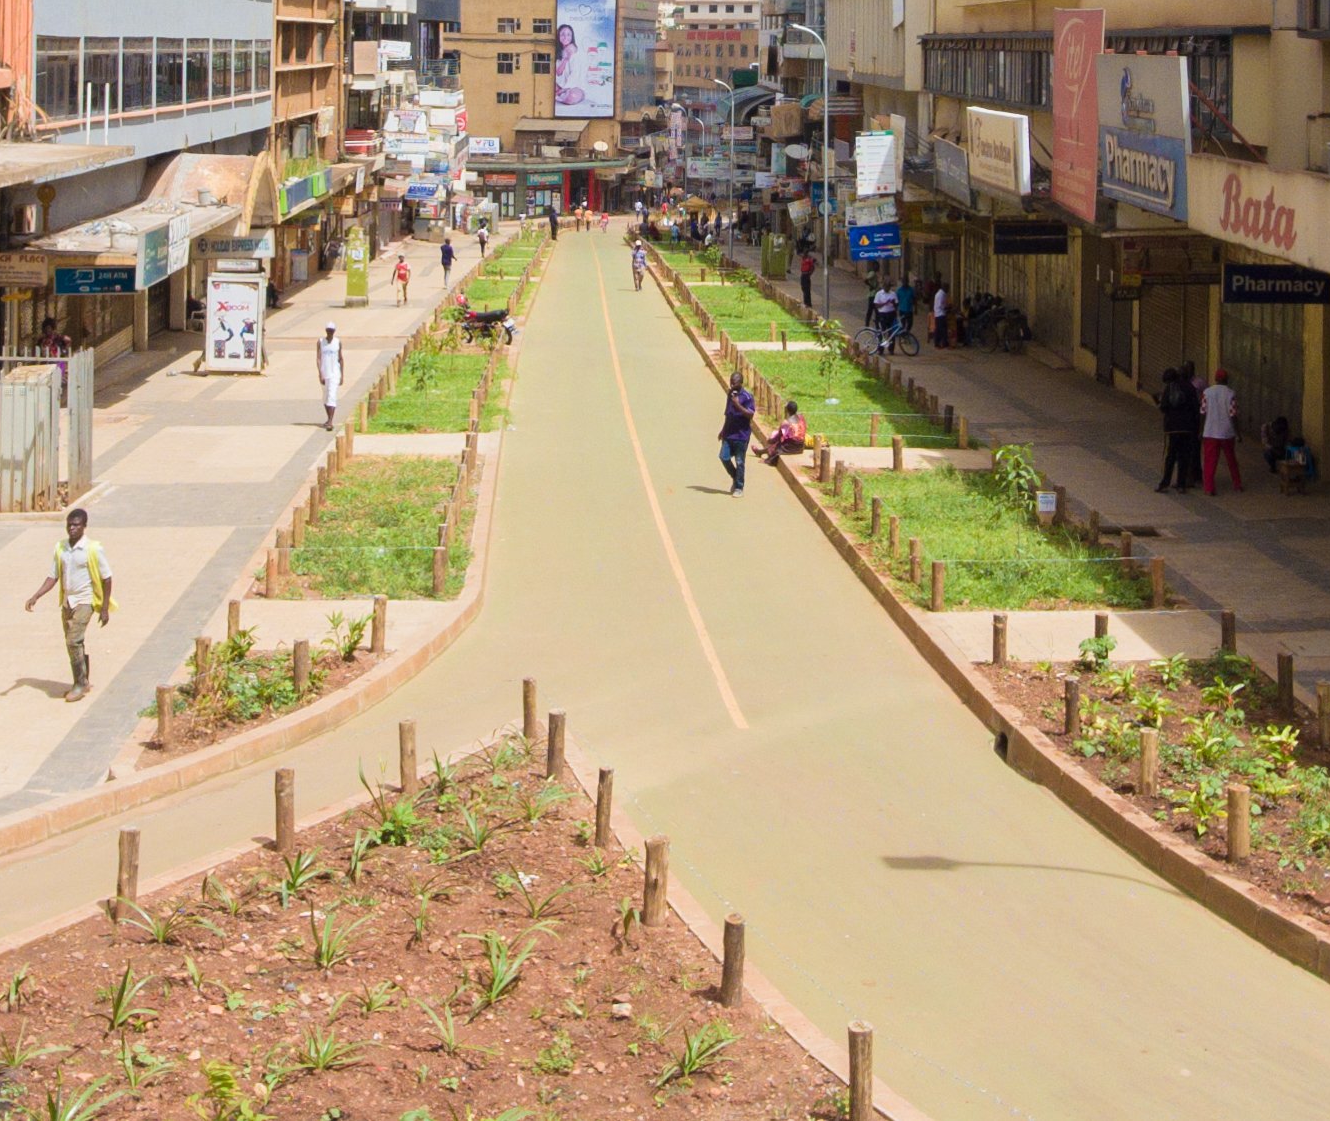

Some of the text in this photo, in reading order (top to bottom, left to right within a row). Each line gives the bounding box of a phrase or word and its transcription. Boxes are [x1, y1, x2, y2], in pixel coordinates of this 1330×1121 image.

[1104, 133, 1176, 201] Pharmacy
[1220, 173, 1297, 251] Bata
[1231, 275, 1325, 296] Pharmacy
